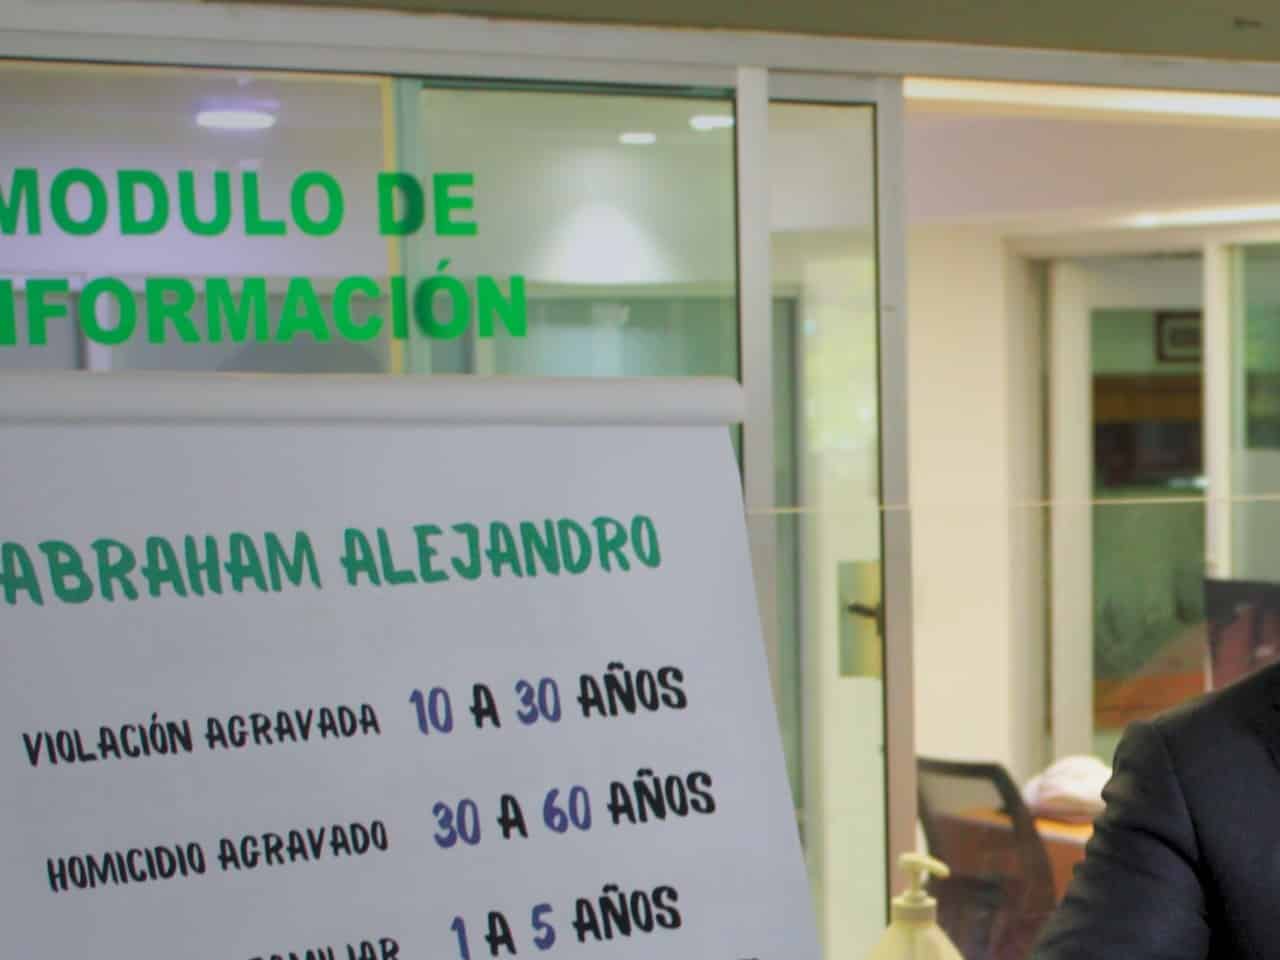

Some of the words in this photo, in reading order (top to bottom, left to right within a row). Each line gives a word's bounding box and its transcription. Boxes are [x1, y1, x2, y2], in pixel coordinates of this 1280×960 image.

[0, 168, 345, 237] MODULO
[378, 172, 479, 237] DE
[0, 531, 323, 606] ABRAHAM
[340, 515, 662, 588] ALEJANDRO
[22, 712, 193, 767] VIOLACIÓN
[205, 703, 382, 750] AGRAVADA
[409, 686, 454, 736] 10
[469, 682, 502, 729] A
[515, 676, 562, 726] 30
[577, 661, 688, 718] AÑOS
[46, 841, 207, 893] HOMICIDIO
[218, 819, 389, 871] AGRAVADO
[432, 798, 481, 849] 30
[496, 793, 529, 840] A
[543, 785, 592, 835] 60
[607, 767, 717, 826] AÑOS
[485, 910, 517, 958] A
[530, 902, 557, 951] 5
[572, 883, 683, 944] AÑOS
